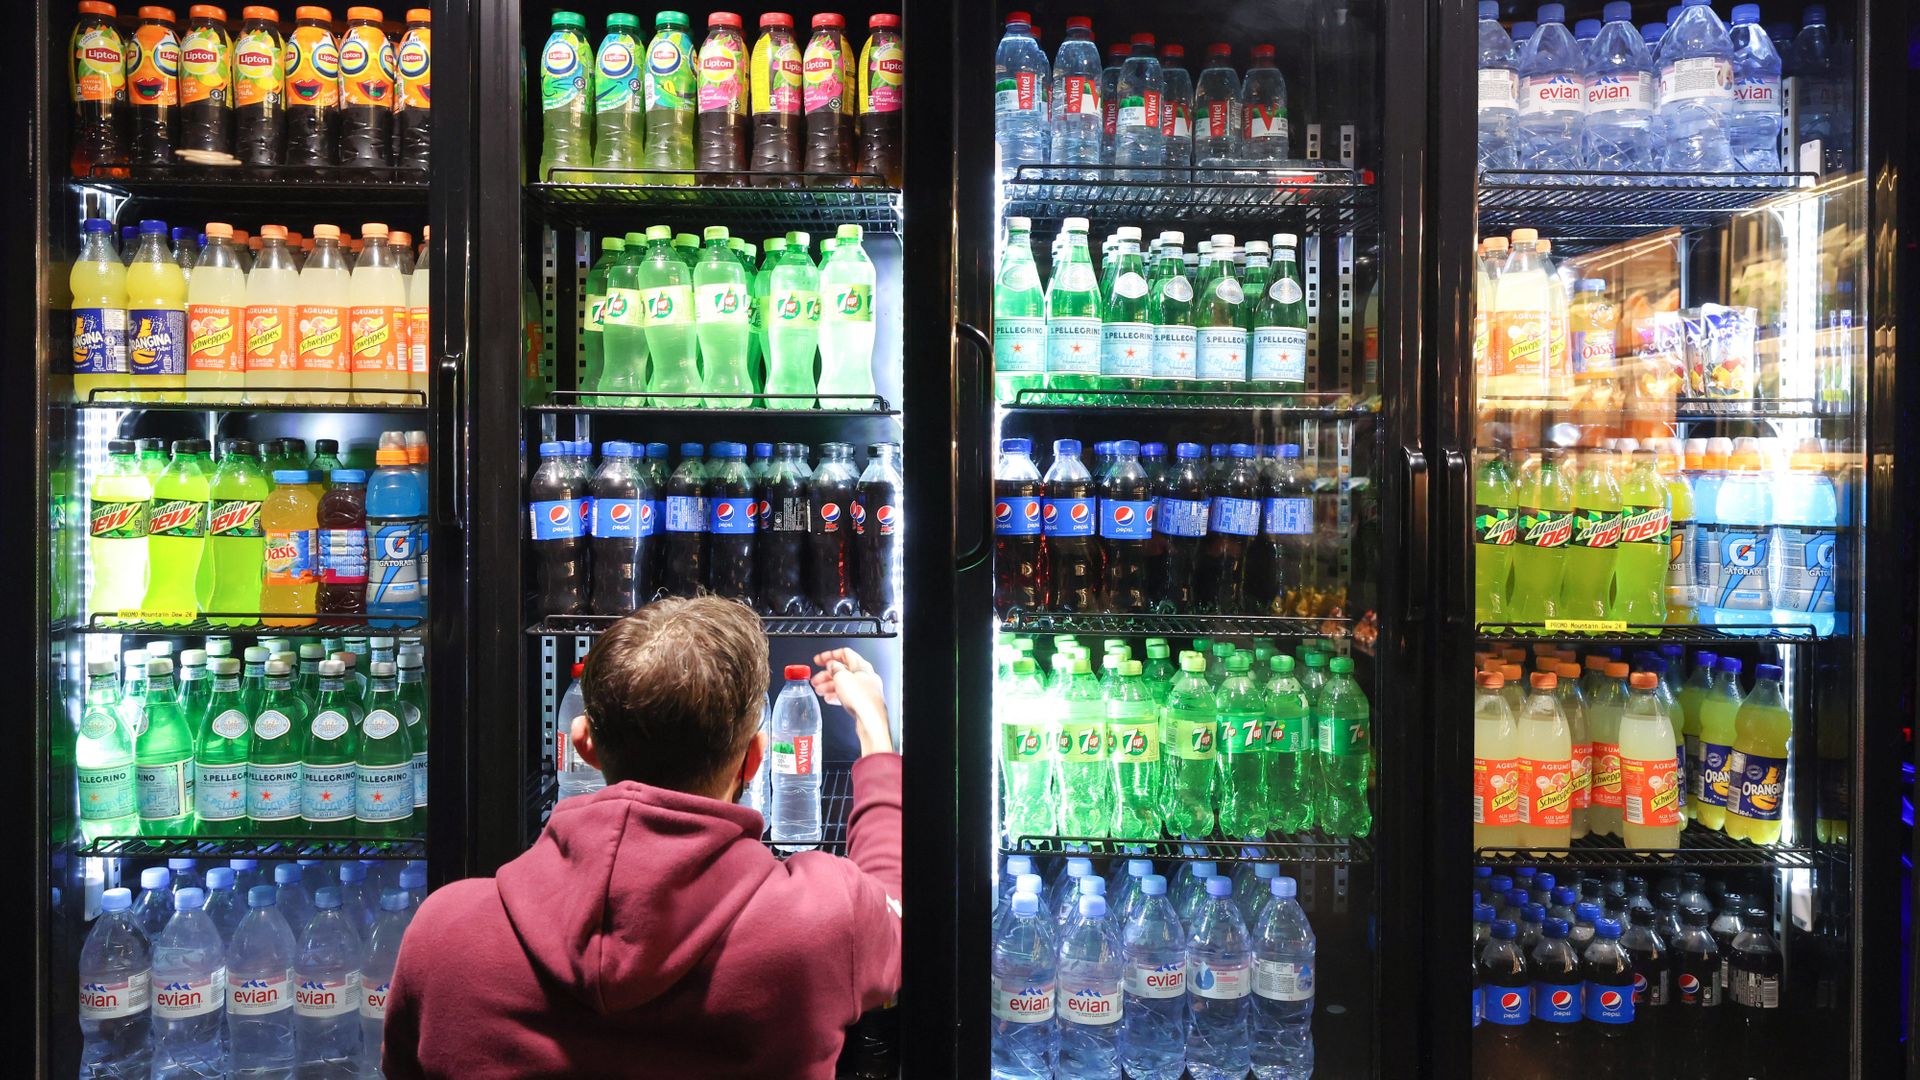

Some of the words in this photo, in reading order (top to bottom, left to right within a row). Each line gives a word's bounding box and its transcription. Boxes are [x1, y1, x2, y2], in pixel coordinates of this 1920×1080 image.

[88, 50, 119, 61] Lipton
[162, 51, 178, 60] Lipto
[185, 50, 214, 61] Lipton
[240, 54, 269, 66] Lipton
[343, 52, 360, 60] Lipton
[404, 54, 421, 62] Lipton
[549, 52, 570, 60] Lipton
[605, 54, 626, 62] Lipton
[654, 51, 674, 59] Lipton
[705, 60, 731, 69] Lipton
[785, 61, 801, 71] Lipto
[806, 60, 829, 70] Lipton
[882, 61, 902, 71] Lipto
[1021, 76, 1031, 100] Vittel
[1070, 79, 1080, 103] Vittel
[1540, 85, 1580, 100] evian
[1589, 85, 1629, 102] evian
[1733, 86, 1773, 100] evian
[1106, 103, 1116, 126] Vittel
[1147, 94, 1157, 122] Vittel
[1163, 104, 1173, 127] Vittel
[1212, 104, 1222, 127] Vittel
[194, 307, 230, 315] AGRUMES
[73, 331, 104, 348] ANGINA
[129, 333, 171, 351] RANGINA
[192, 330, 230, 351] Schweppes
[301, 330, 339, 351] Schweppes
[1510, 340, 1541, 356] Schwepp
[1583, 344, 1614, 359] Oasis
[1531, 514, 1573, 537] Mounta
[1583, 514, 1621, 538] Mounta
[1538, 523, 1572, 547] De
[1588, 525, 1621, 547] De
[1570, 622, 1599, 630] Mountain
[798, 739, 810, 766] Vittel
[203, 771, 248, 782] S.PELLEGR
[1592, 771, 1620, 785] chwepp
[1705, 769, 1730, 783] ORAN
[1147, 971, 1183, 987] evian
[80, 992, 117, 1007] evian
[157, 991, 201, 1007] evian
[234, 989, 278, 1003] evian
[296, 990, 335, 1005] evian
[1010, 997, 1050, 1011] evian
[1068, 998, 1110, 1013] evian
